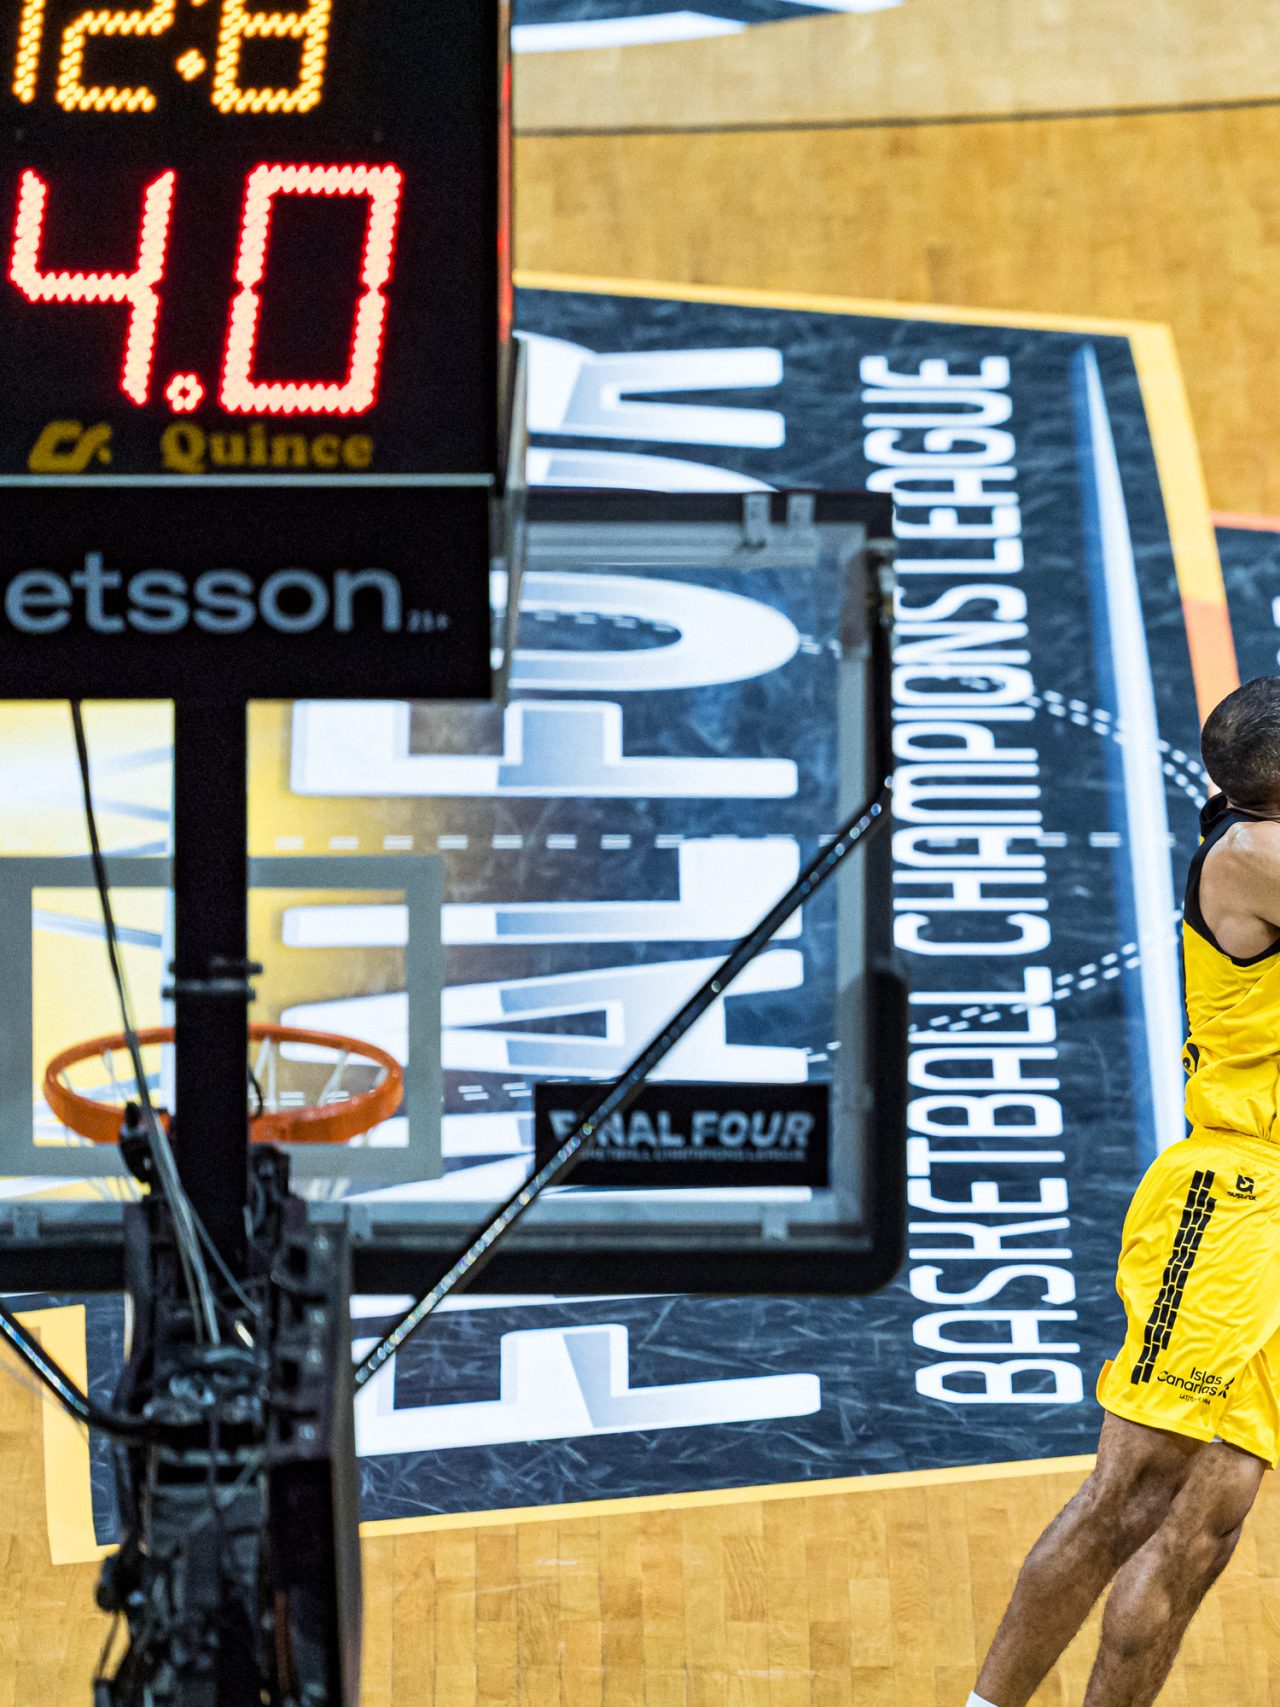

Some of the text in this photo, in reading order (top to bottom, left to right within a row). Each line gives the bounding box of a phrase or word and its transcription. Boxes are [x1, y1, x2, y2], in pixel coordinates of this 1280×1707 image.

[8, 161, 402, 415] 4.0
[160, 419, 375, 475] Quince
[860, 355, 1084, 1405] BASKETBALL CHAMPIONS LEAGUE
[549, 1110, 815, 1148] FNAL FOUR
[1157, 1370, 1218, 1396] Canarias
[1190, 1366, 1223, 1385] Islas
